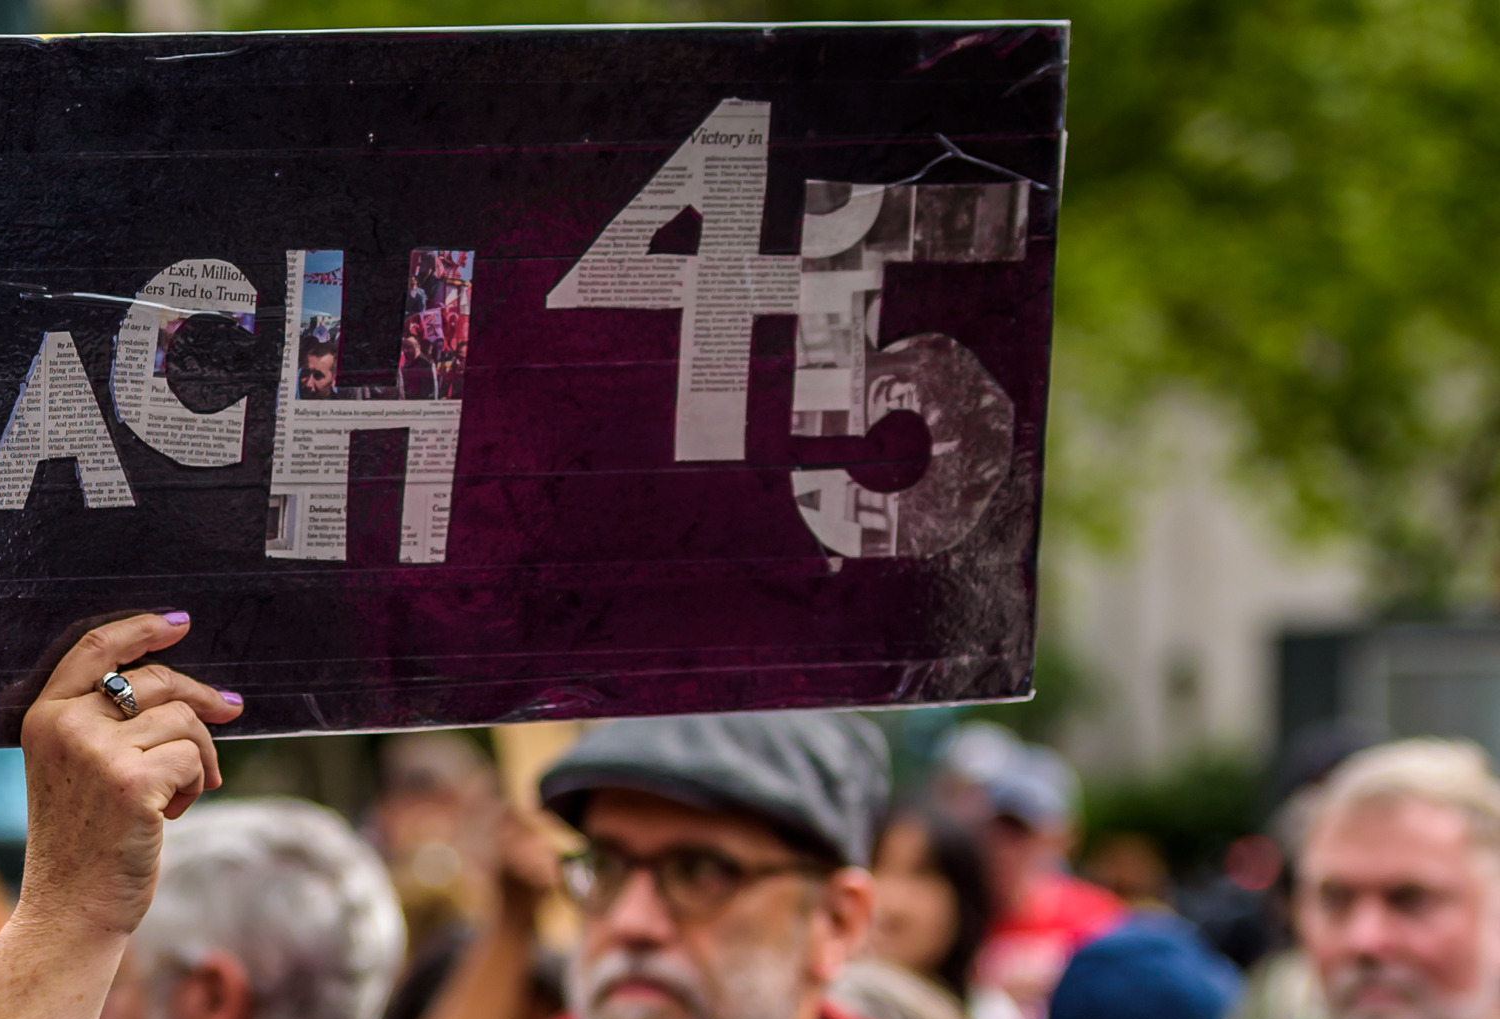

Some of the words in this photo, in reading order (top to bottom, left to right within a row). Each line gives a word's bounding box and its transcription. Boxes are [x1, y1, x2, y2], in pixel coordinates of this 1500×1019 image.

[748, 128, 763, 145] in
[169, 264, 198, 280] Exit,
[168, 282, 197, 299] Tied
[200, 287, 213, 300] to
[216, 285, 257, 306] Trump
[130, 324, 142, 332] day
[142, 324, 152, 332] for
[546, 99, 1031, 560] 45
[49, 382, 88, 390] documentary
[151, 386, 166, 394] Paul
[148, 414, 167, 423] Trump
[309, 505, 342, 515] Debating
